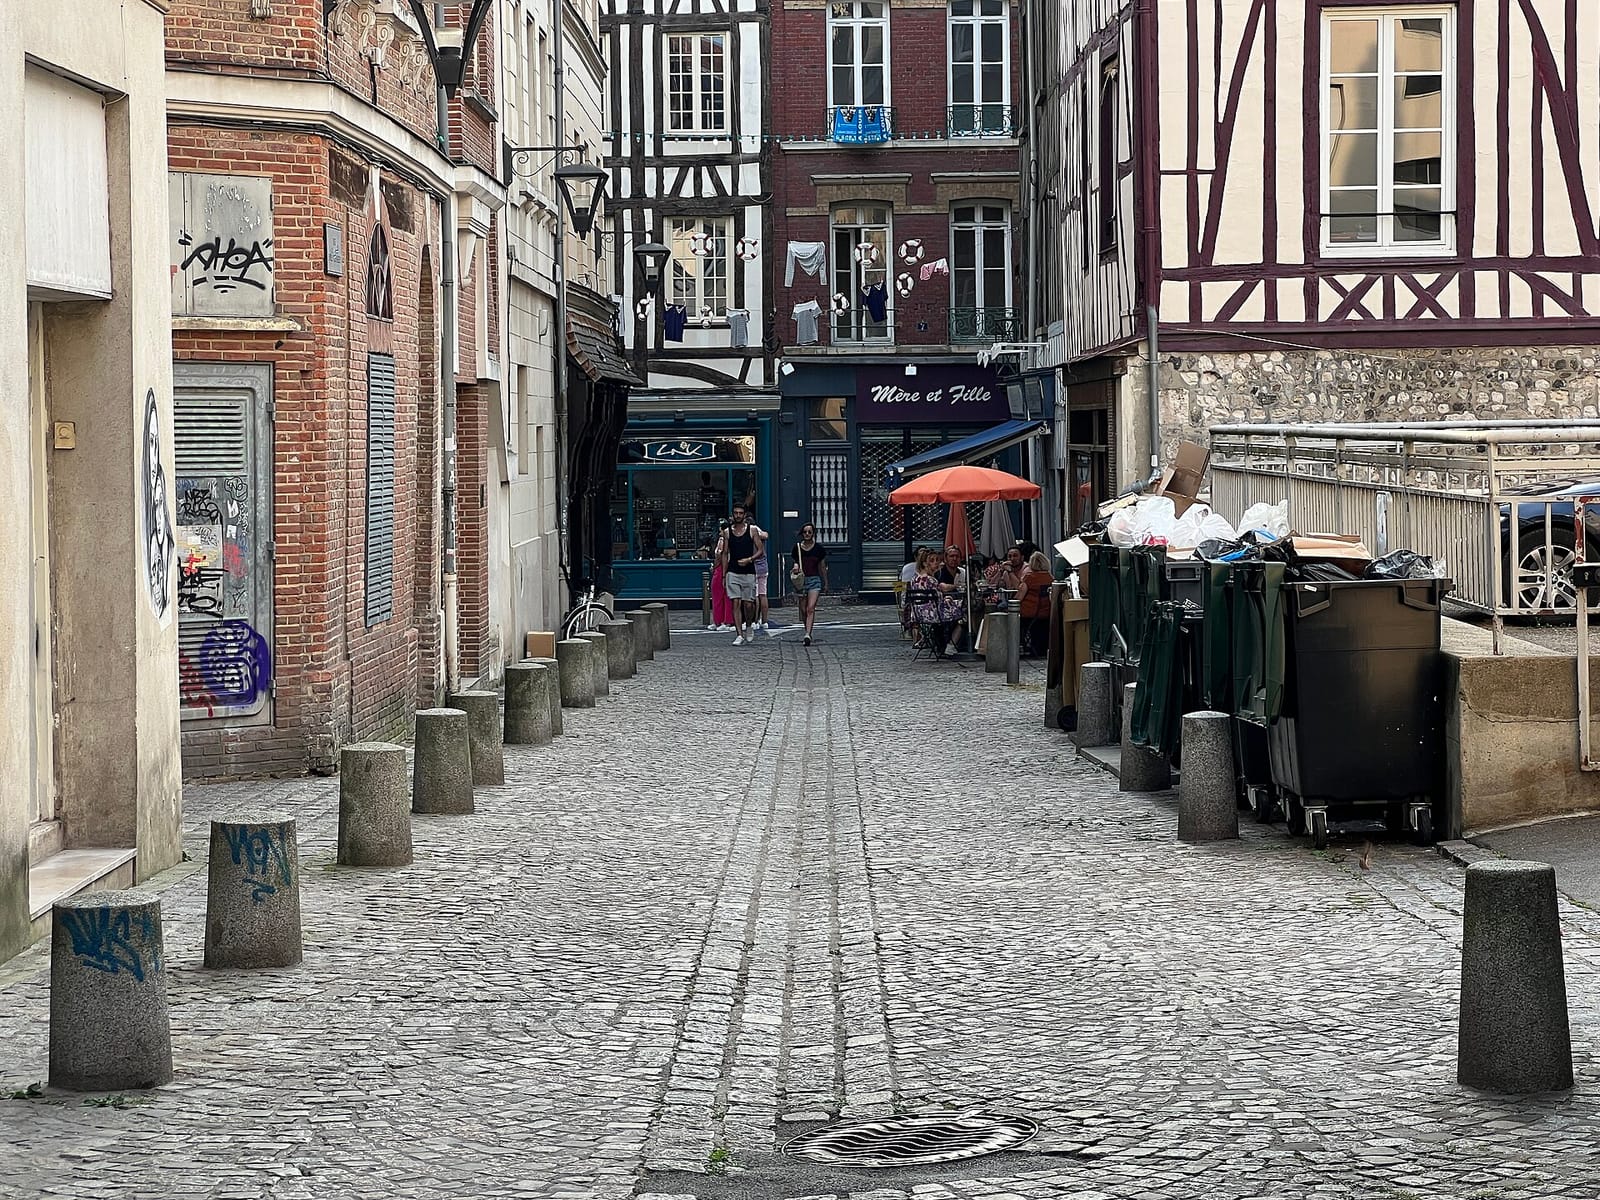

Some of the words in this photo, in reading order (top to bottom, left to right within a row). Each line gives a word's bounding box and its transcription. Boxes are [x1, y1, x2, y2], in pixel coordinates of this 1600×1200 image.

[870, 384, 921, 403] Mère
[926, 388, 943, 402] et
[948, 384, 992, 405] Fille
